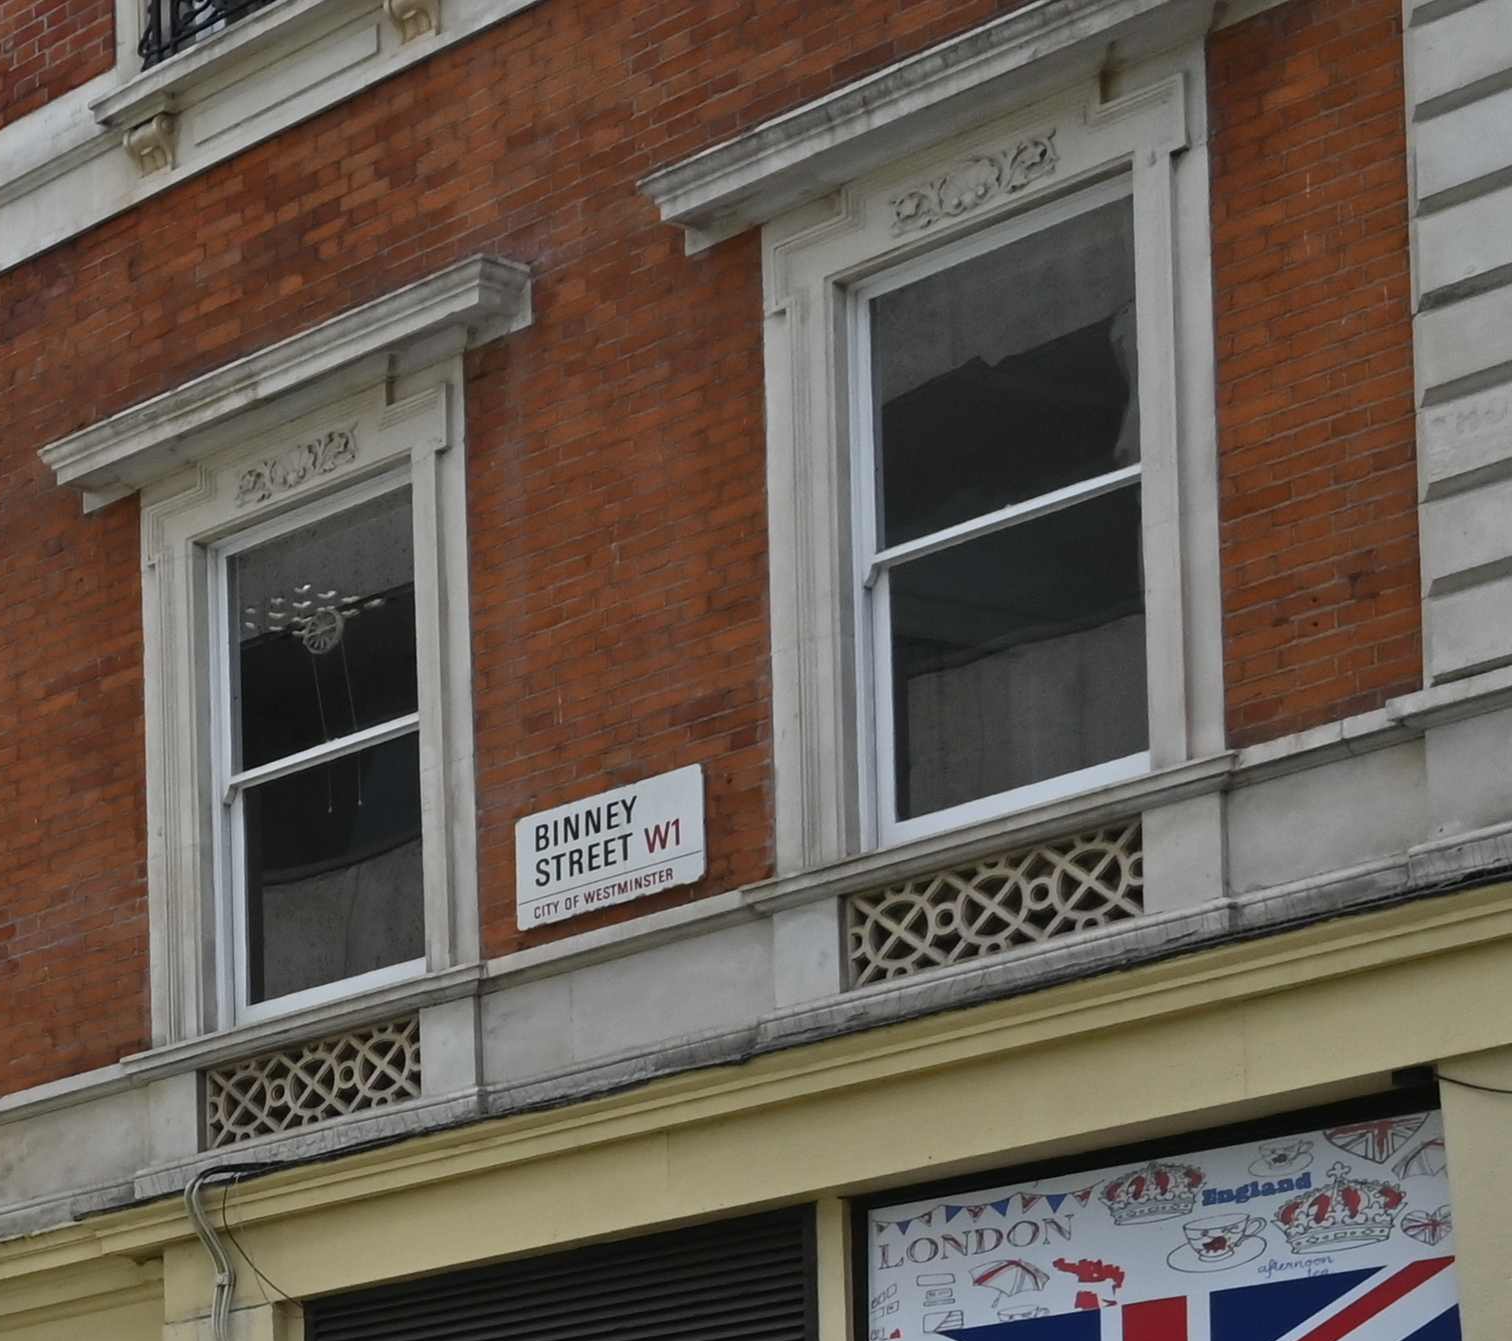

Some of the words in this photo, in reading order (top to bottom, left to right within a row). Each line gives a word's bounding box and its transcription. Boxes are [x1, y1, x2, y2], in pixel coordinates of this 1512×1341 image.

[535, 796, 637, 852] BINNEY
[535, 833, 633, 886] STREET
[644, 818, 680, 854] W1
[534, 900, 560, 919] CITY
[564, 895, 580, 911] OF
[584, 867, 674, 904] WESTMINSTER
[1202, 1172, 1312, 1206] England
[878, 1214, 1074, 1270] LONDON
[1257, 1256, 1335, 1278] afternoon
